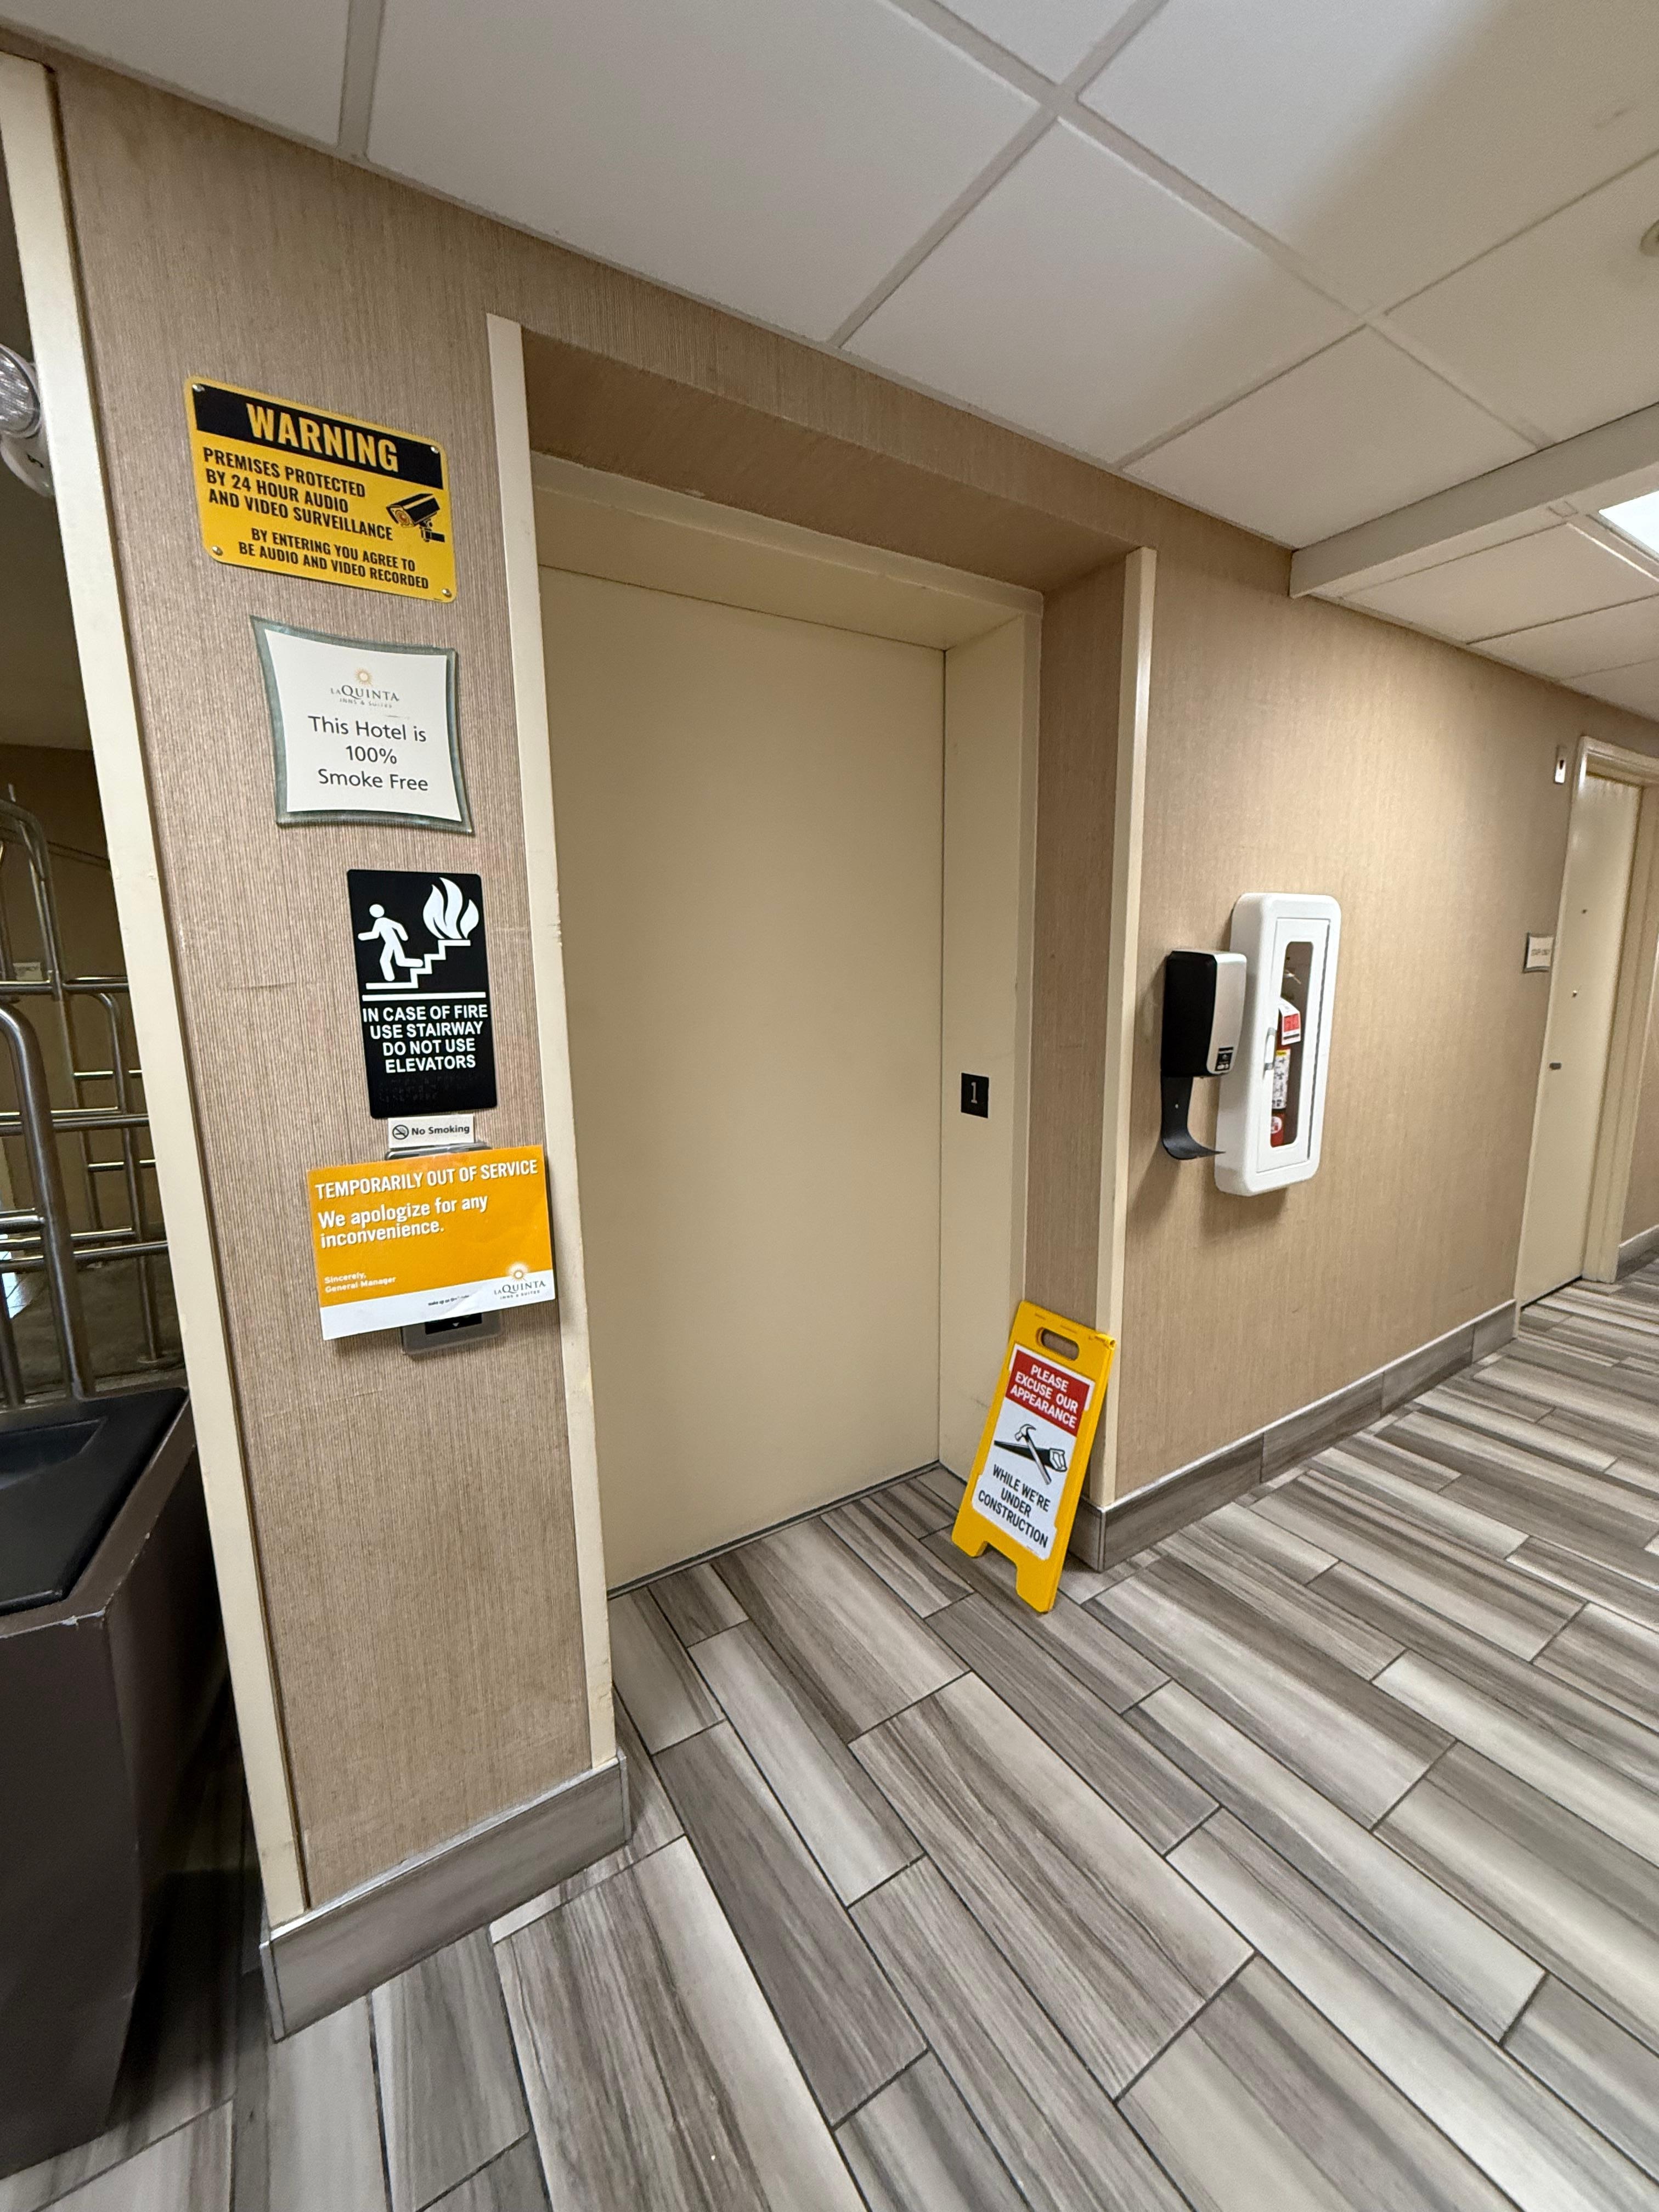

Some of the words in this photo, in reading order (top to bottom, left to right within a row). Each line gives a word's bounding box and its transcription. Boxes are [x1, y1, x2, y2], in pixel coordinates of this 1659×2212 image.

[246, 403, 399, 472] WARNING
[203, 447, 281, 478] PREMISES
[285, 466, 366, 498] PROTECTED
[206, 468, 225, 485] BY
[232, 474, 251, 492] 24
[256, 479, 299, 502] HOUR
[304, 490, 349, 514] AUDIO
[208, 488, 239, 508] AND
[245, 496, 289, 518] VIDEO
[294, 507, 393, 541] SURVEILLANCE
[239, 541, 256, 556] BE
[259, 546, 298, 565] AUDIO
[303, 554, 328, 569] AND
[331, 560, 366, 577] VIDEO
[370, 567, 428, 589] RECORDED
[251, 528, 268, 543] BY
[272, 531, 331, 555] ENTERING
[334, 544, 358, 560] YOU
[363, 550, 399, 568] AGREE
[401, 558, 415, 572] TO
[308, 715, 348, 735] This
[356, 720, 407, 741] Hotel
[414, 726, 426, 742] is
[346, 745, 397, 764] 100%
[318, 769, 383, 788] Smoke
[390, 774, 428, 791] Free
[363, 1008, 379, 1022] IN
[383, 1006, 426, 1022] CASE
[430, 1005, 450, 1019] OF
[454, 1004, 488, 1019] FIRE
[370, 1024, 403, 1039] USE
[406, 1021, 483, 1038] STAIRWAY
[383, 1041, 406, 1056] DO
[410, 1040, 442, 1054] NOT
[445, 1038, 476, 1053] USE
[385, 1054, 476, 1074] ELEVATORS
[971, 1081, 978, 1104] 1
[428, 1125, 470, 1135] Smoking
[315, 1172, 422, 1200] TEMPORARILY
[427, 1169, 456, 1186] OUT
[459, 1166, 477, 1182] OF
[481, 1159, 538, 1180] SERVICE
[318, 1210, 346, 1229] We
[351, 1200, 430, 1228] apologize
[435, 1197, 456, 1214] for
[461, 1195, 488, 1213] any
[320, 1220, 444, 1249] inconvenience.
[324, 1272, 366, 1284] Sincerely,
[325, 1281, 358, 1293] General
[360, 1277, 396, 1288] Manager
[1015, 1371, 1053, 1400] EXCUSE
[1055, 1393, 1079, 1414] OUR
[1030, 1364, 1069, 1393] PLEASE
[1010, 1384, 1077, 1429] APPEARANCE
[993, 1464, 1021, 1492] WHILE
[1022, 1483, 1051, 1513] WE'RE
[1001, 1487, 1031, 1518] UNDER
[978, 1489, 1048, 1548] CONSTRUCTION
